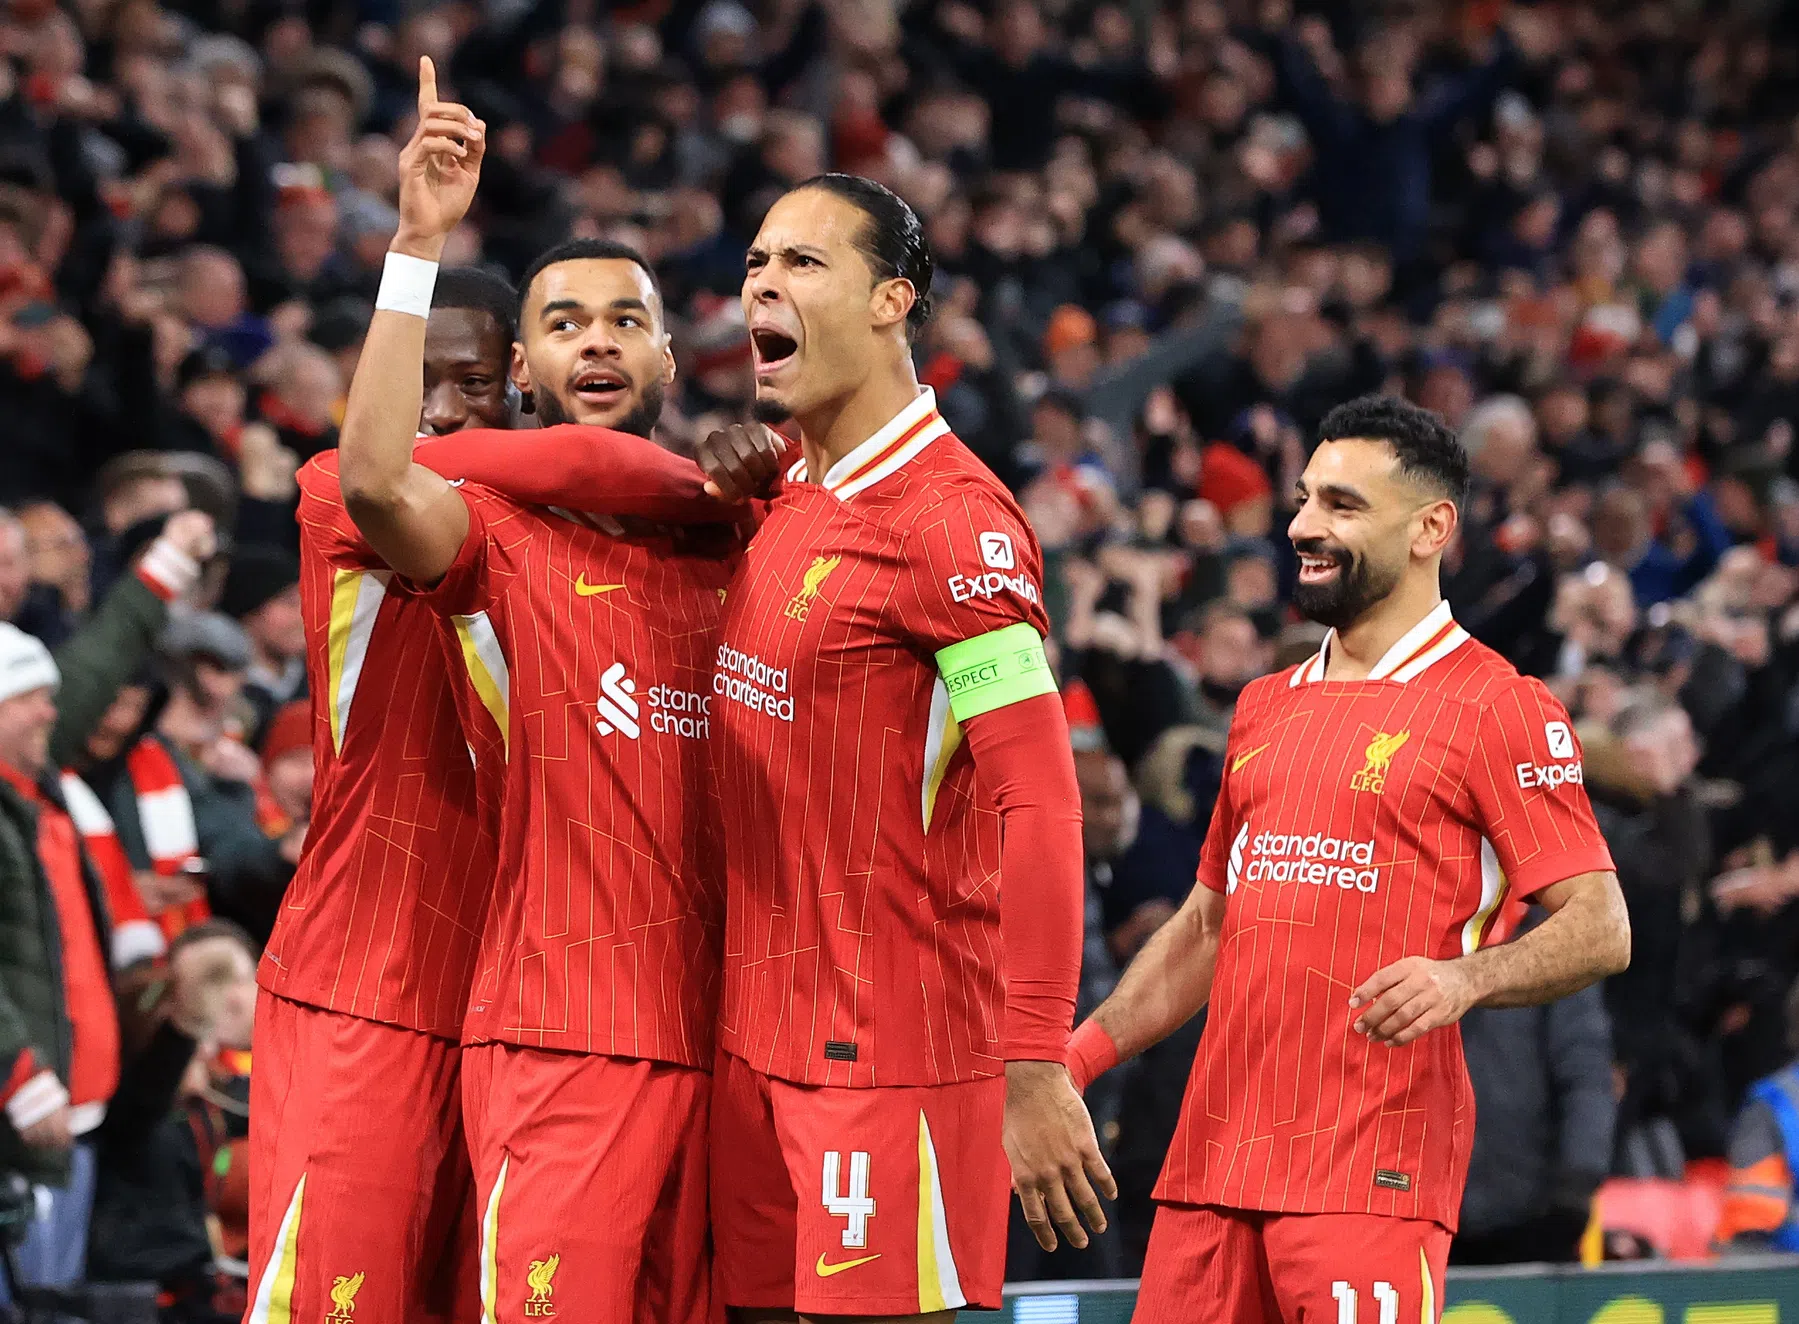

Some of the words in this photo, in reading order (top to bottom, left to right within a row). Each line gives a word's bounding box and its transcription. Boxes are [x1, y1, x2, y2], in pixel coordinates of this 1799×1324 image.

[948, 572, 1037, 604] Expedia
[716, 642, 788, 693] standard
[713, 672, 794, 722] chartered
[1251, 830, 1375, 865] standard
[1246, 856, 1379, 893] chartered
[822, 1151, 876, 1249] 4
[1331, 1281, 1399, 1324] 11
